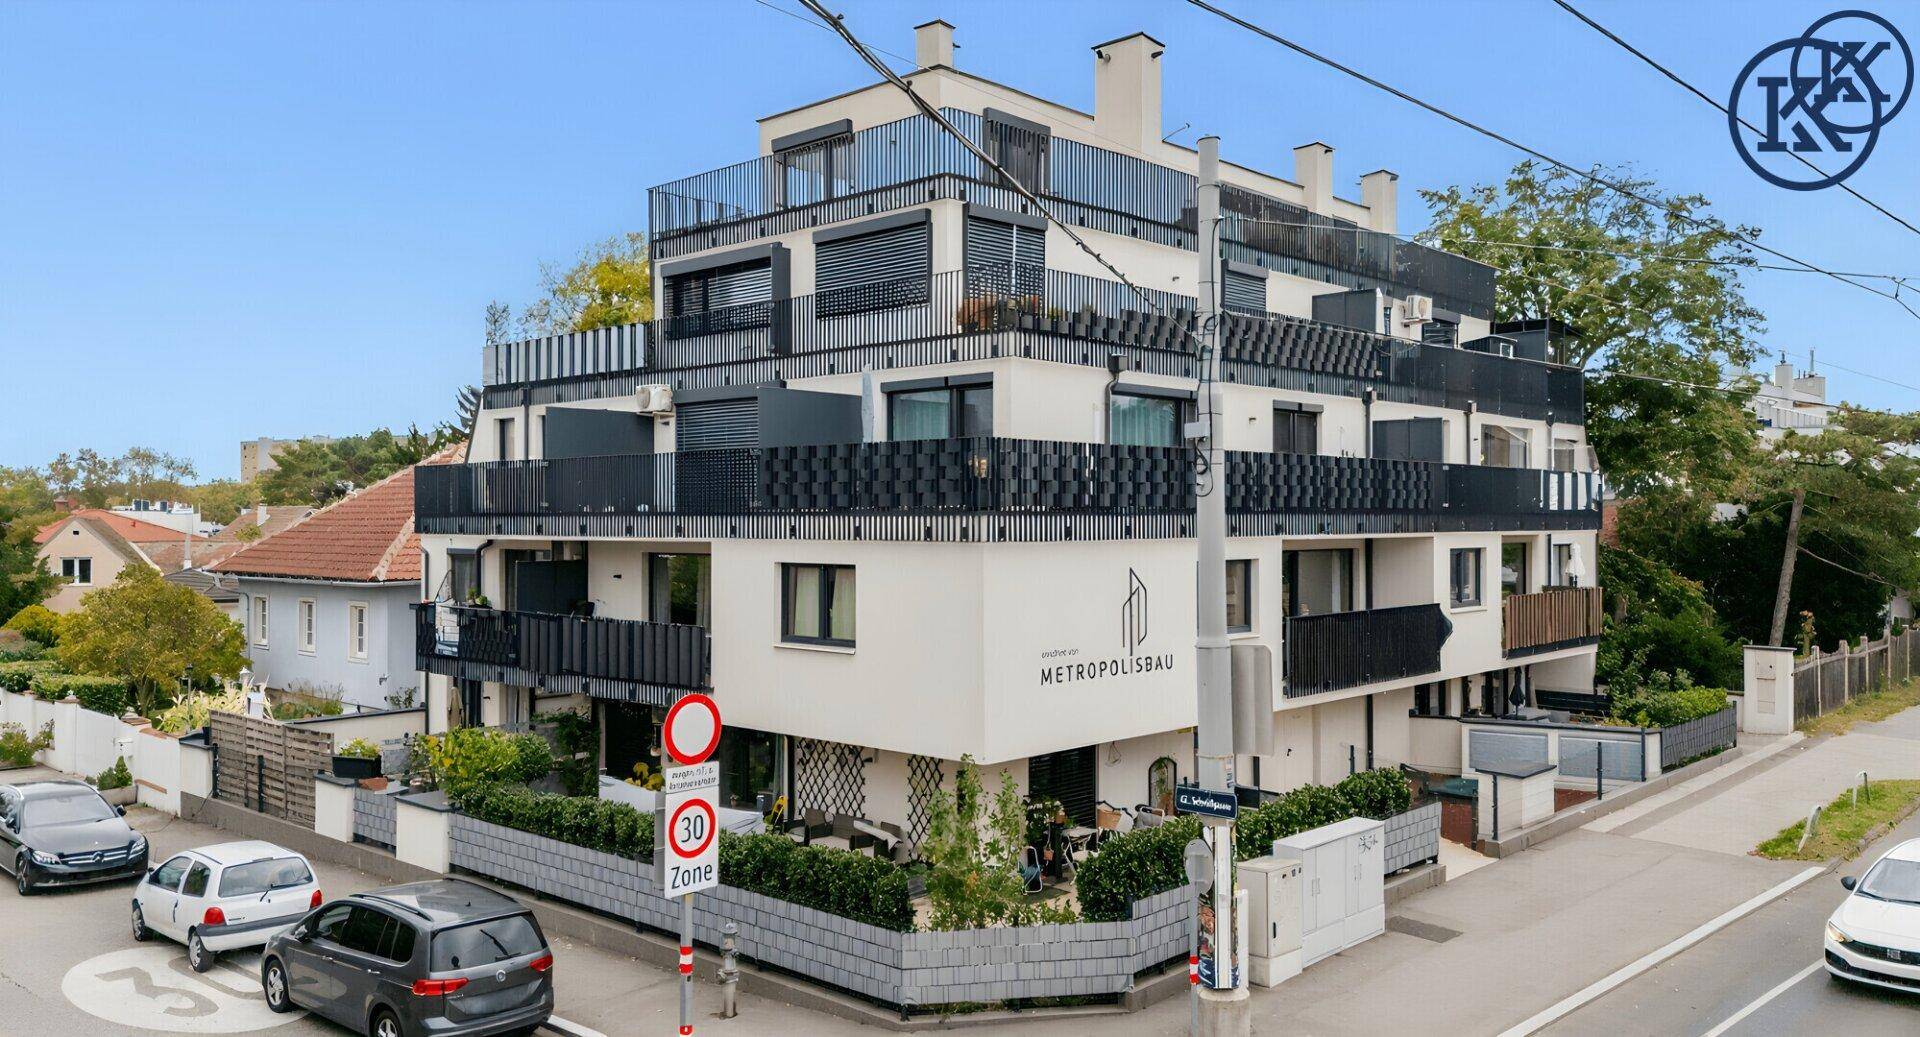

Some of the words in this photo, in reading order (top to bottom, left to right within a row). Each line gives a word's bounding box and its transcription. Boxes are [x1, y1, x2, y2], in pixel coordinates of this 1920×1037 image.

[1040, 654, 1174, 686] METROPOLISBAU
[681, 814, 704, 843] 30
[671, 863, 713, 890] Zone
